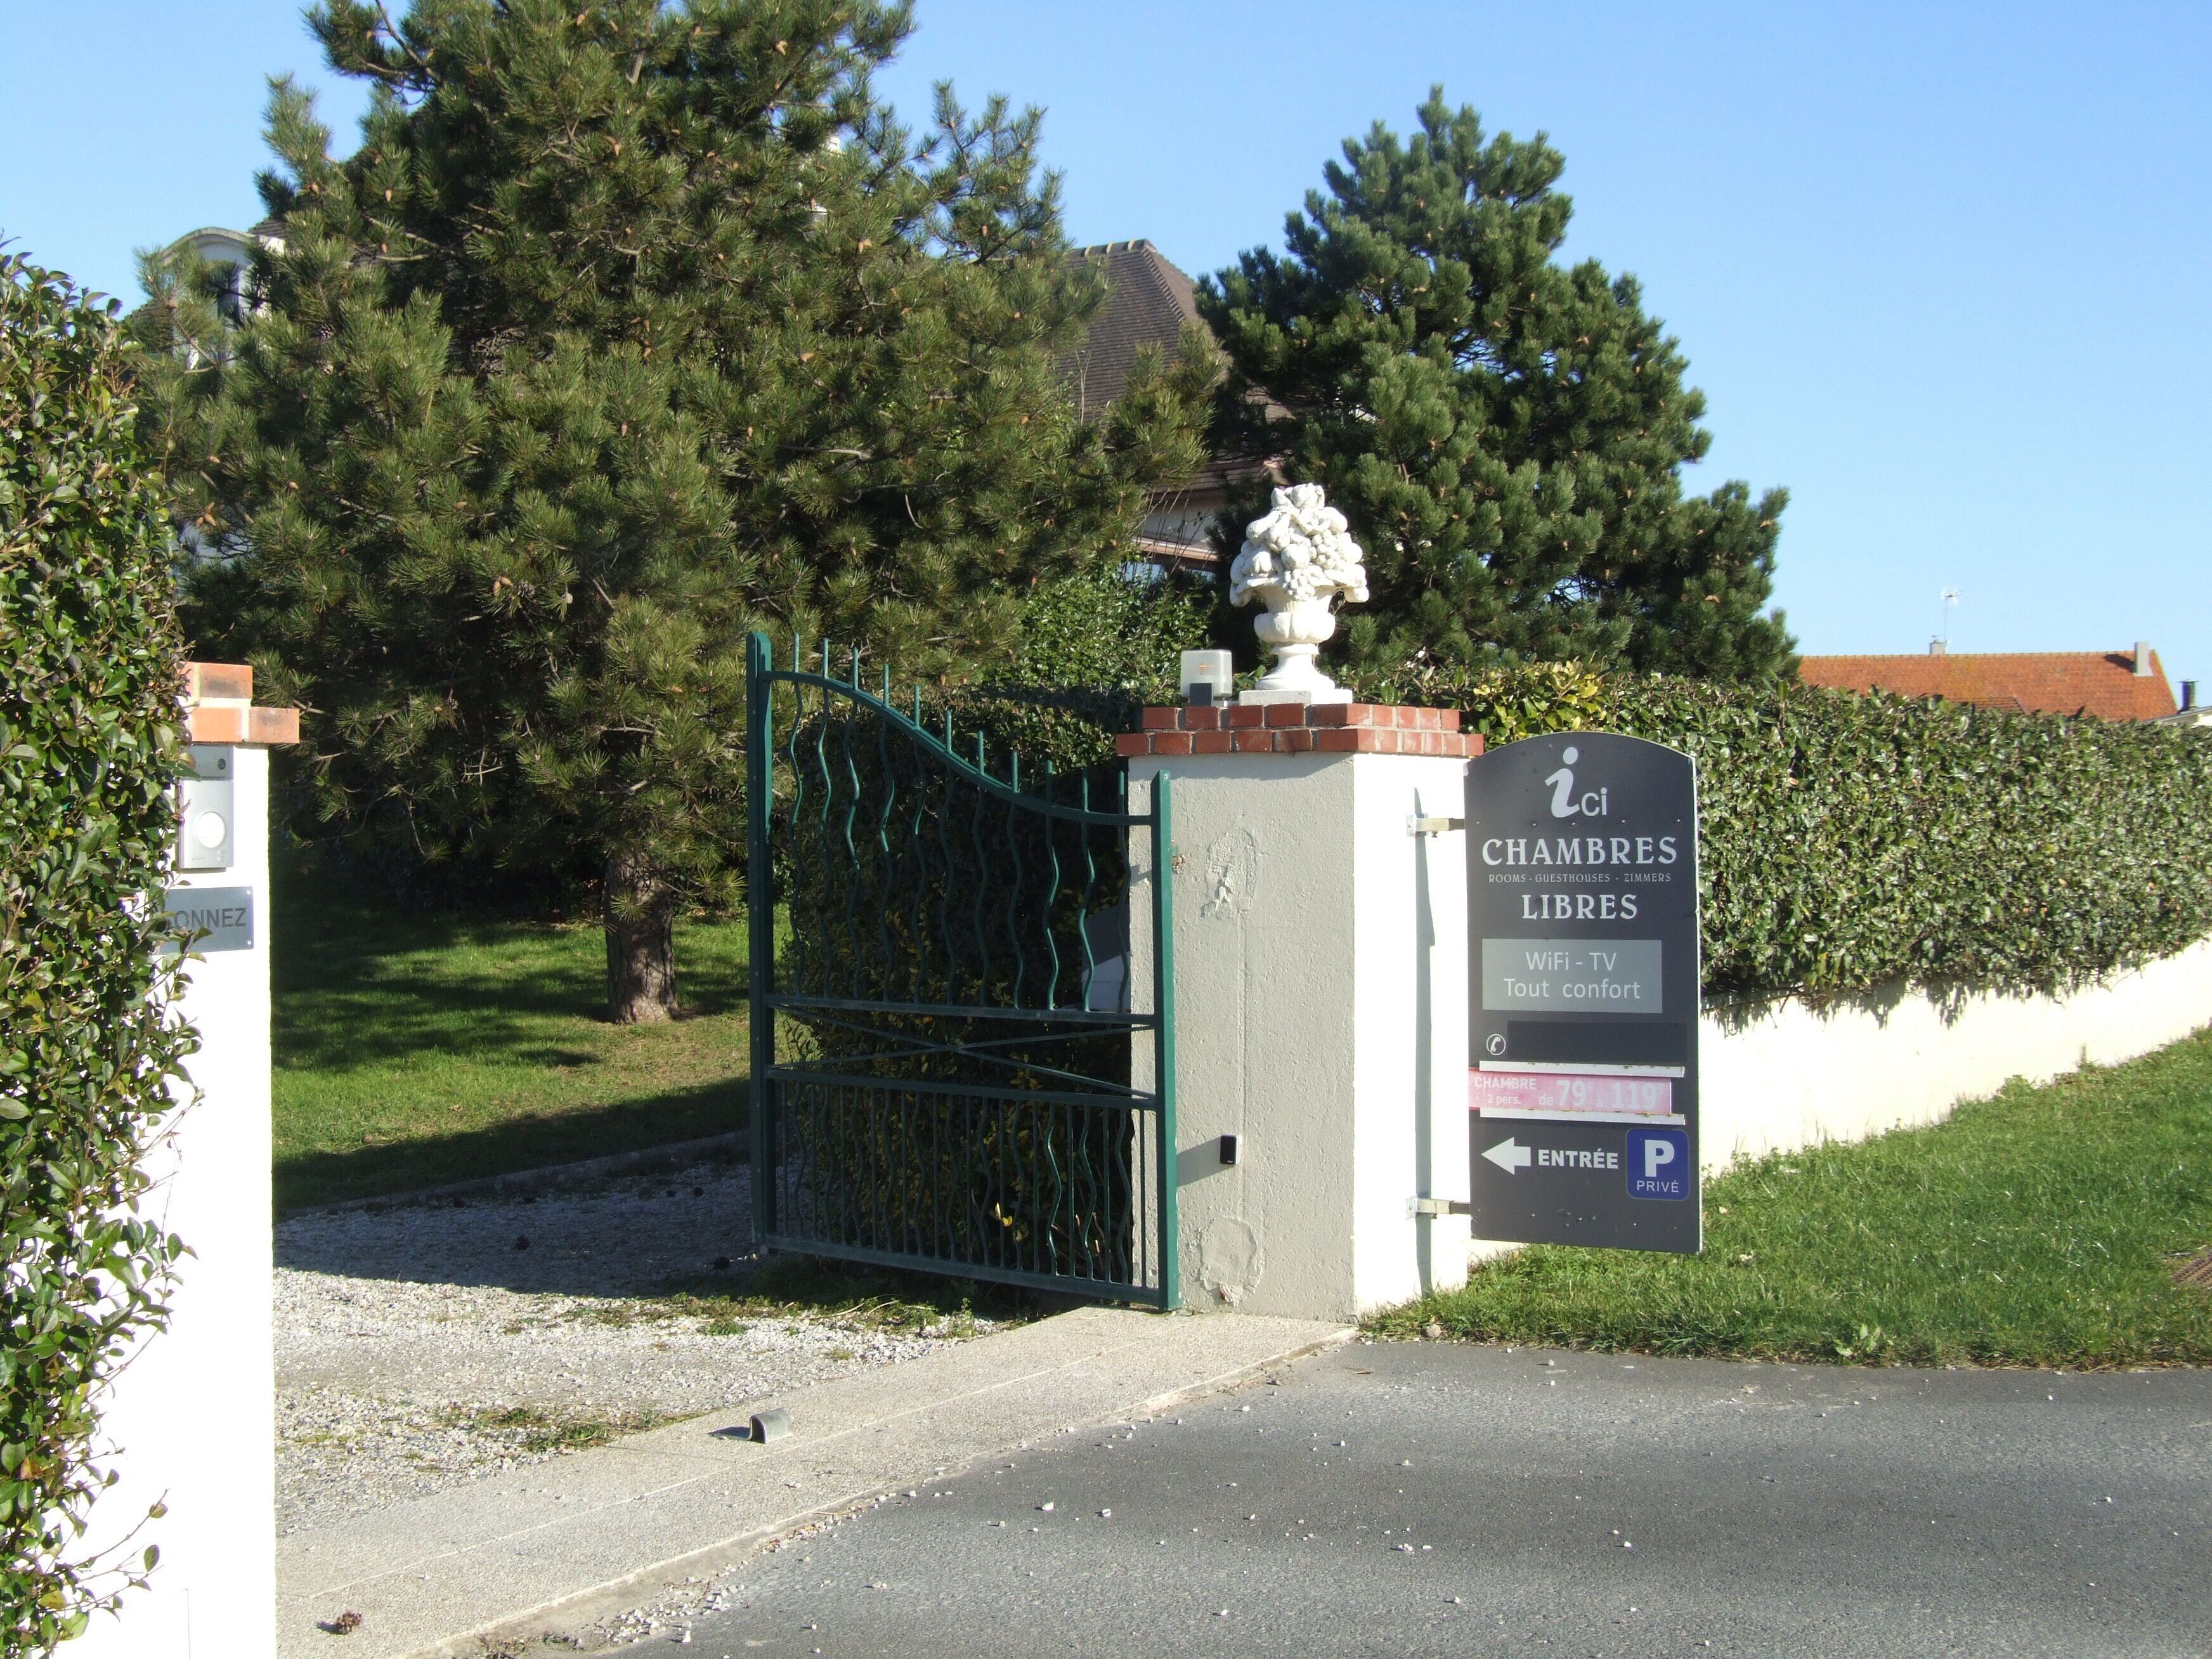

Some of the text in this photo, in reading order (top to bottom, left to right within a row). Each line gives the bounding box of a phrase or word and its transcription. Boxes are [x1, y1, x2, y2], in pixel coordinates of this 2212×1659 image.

[1482, 836, 1677, 866] CHAMBRES
[1488, 874, 1526, 883] ROOMS
[1535, 873, 1610, 883] GUESTHOUSES
[1624, 873, 1671, 882] ZIMMERS
[1522, 894, 1637, 920] LIBRES
[166, 908, 246, 929] ONNEZ
[1525, 951, 1570, 971] WiFi
[1589, 953, 1617, 972] TV
[1503, 978, 1641, 999] Tout confort
[1474, 1076, 1537, 1090] CHAMBRE
[1496, 1094, 1521, 1105] pers.
[1539, 1093, 1554, 1105] de
[1538, 1148, 1618, 1169] ENTRÉE
[1644, 1139, 1675, 1177] P
[1637, 1180, 1679, 1193] PRIVÉ
